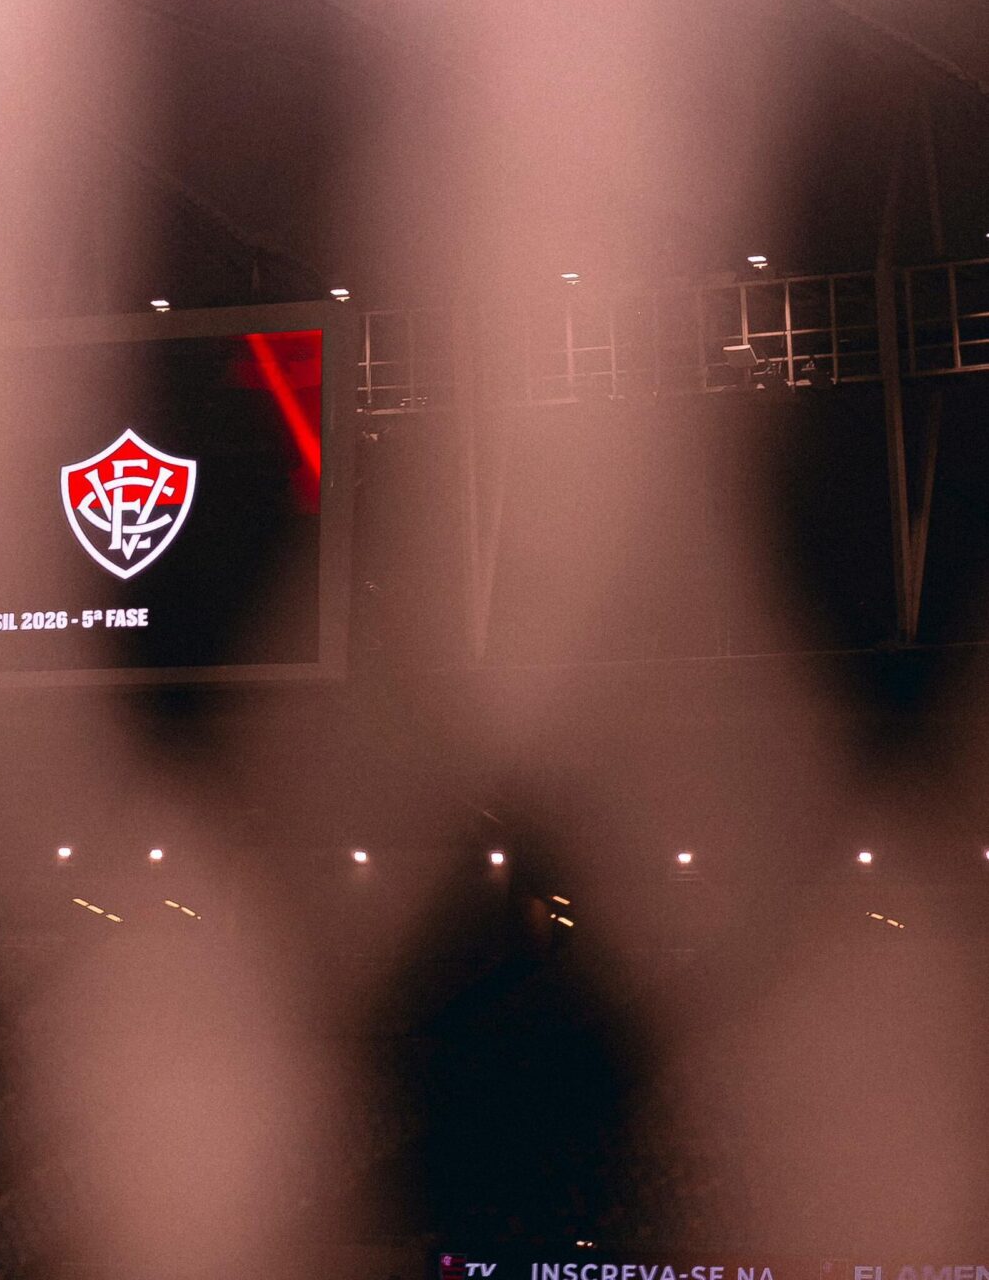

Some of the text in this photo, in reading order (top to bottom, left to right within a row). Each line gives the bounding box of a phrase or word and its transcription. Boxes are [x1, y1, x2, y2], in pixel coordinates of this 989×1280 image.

[20, 610, 69, 631] 2026
[105, 607, 149, 628] FASE
[464, 1262, 497, 1277] TV
